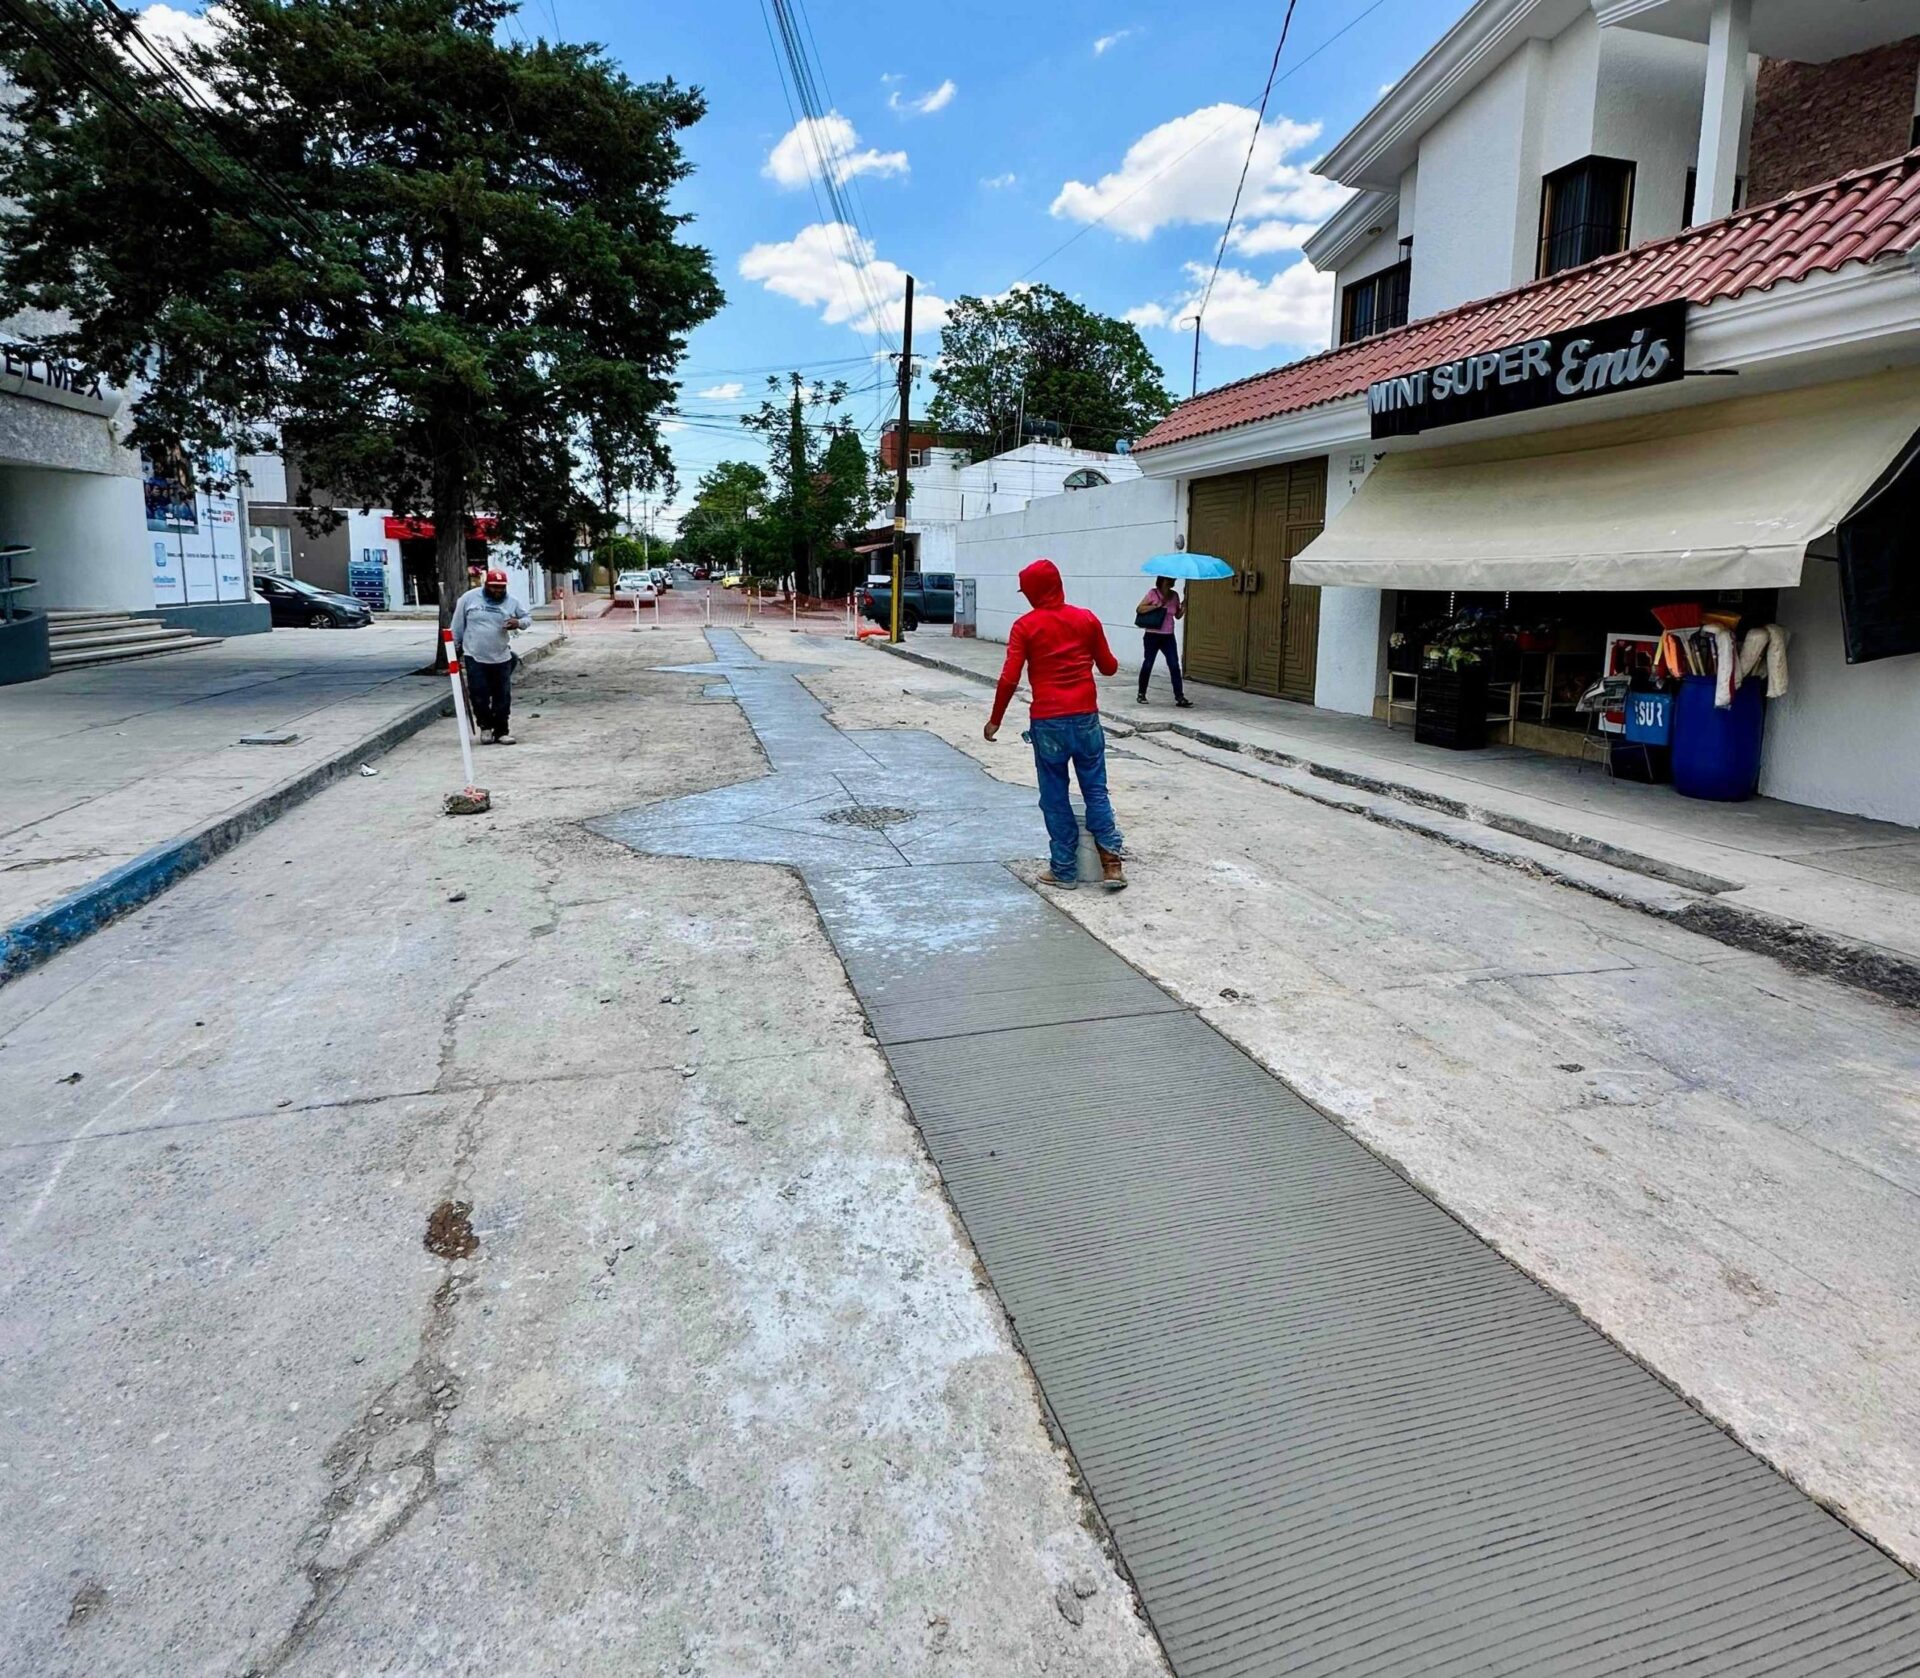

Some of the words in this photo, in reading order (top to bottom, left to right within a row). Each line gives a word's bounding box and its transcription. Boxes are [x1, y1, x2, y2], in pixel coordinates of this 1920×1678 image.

[1367, 371, 1428, 415] MINI
[1432, 340, 1552, 401] SUPER
[1555, 327, 1673, 395] Emis
